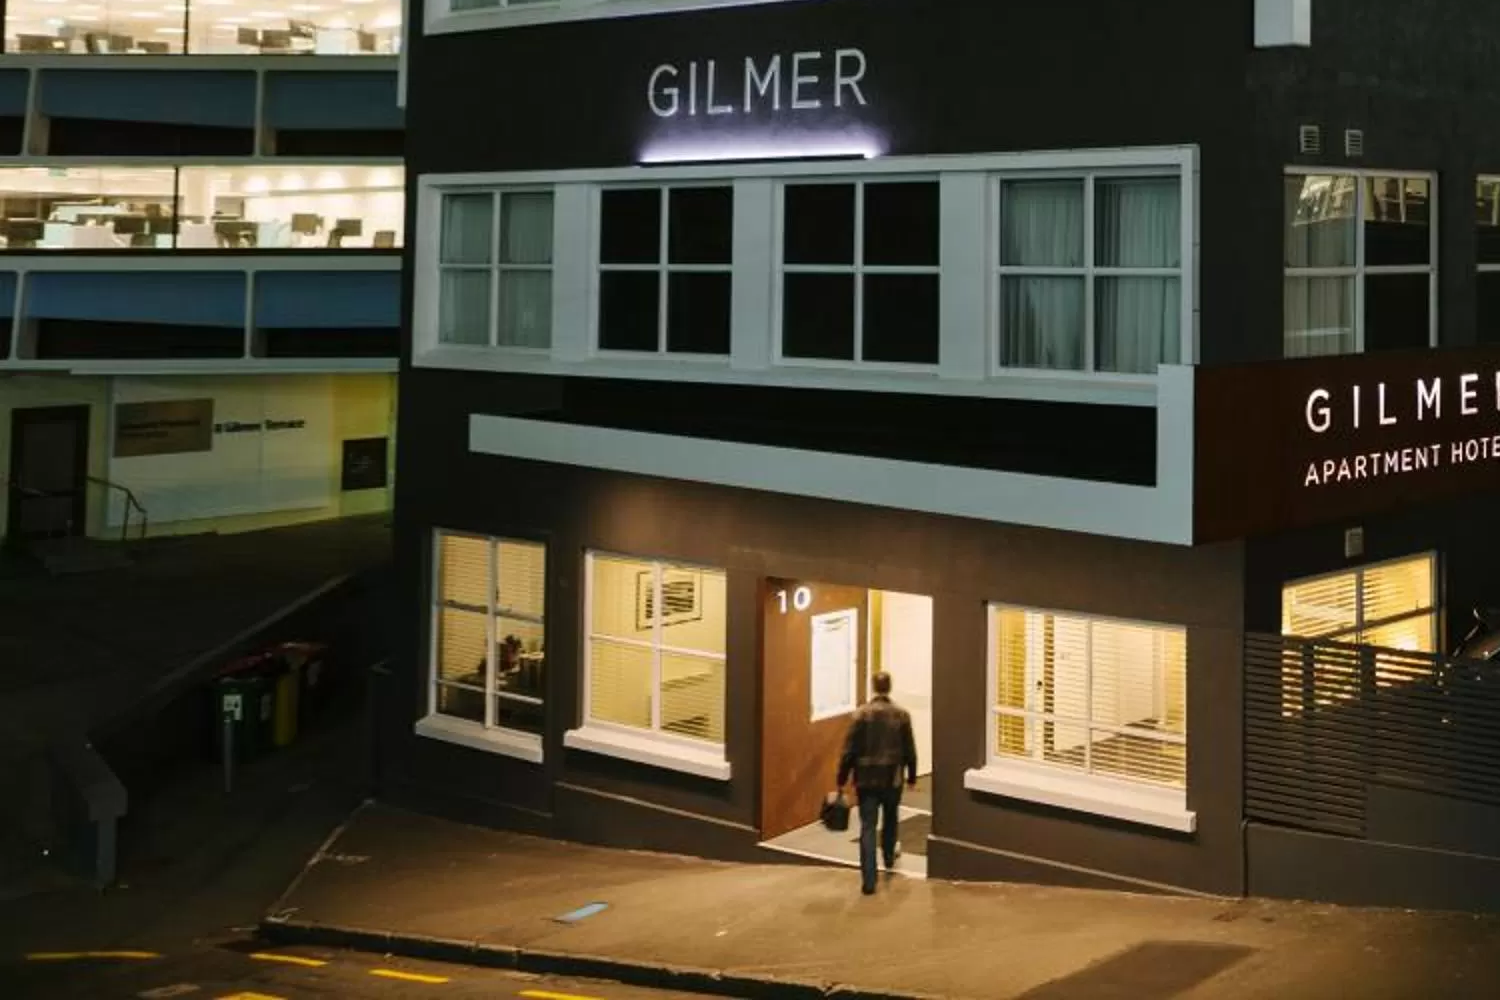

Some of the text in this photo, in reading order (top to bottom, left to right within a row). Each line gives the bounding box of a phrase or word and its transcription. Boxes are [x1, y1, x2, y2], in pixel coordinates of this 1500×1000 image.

[647, 48, 868, 117] GILMER
[1303, 443, 1442, 487] APARTMENT
[776, 586, 811, 614] 10
